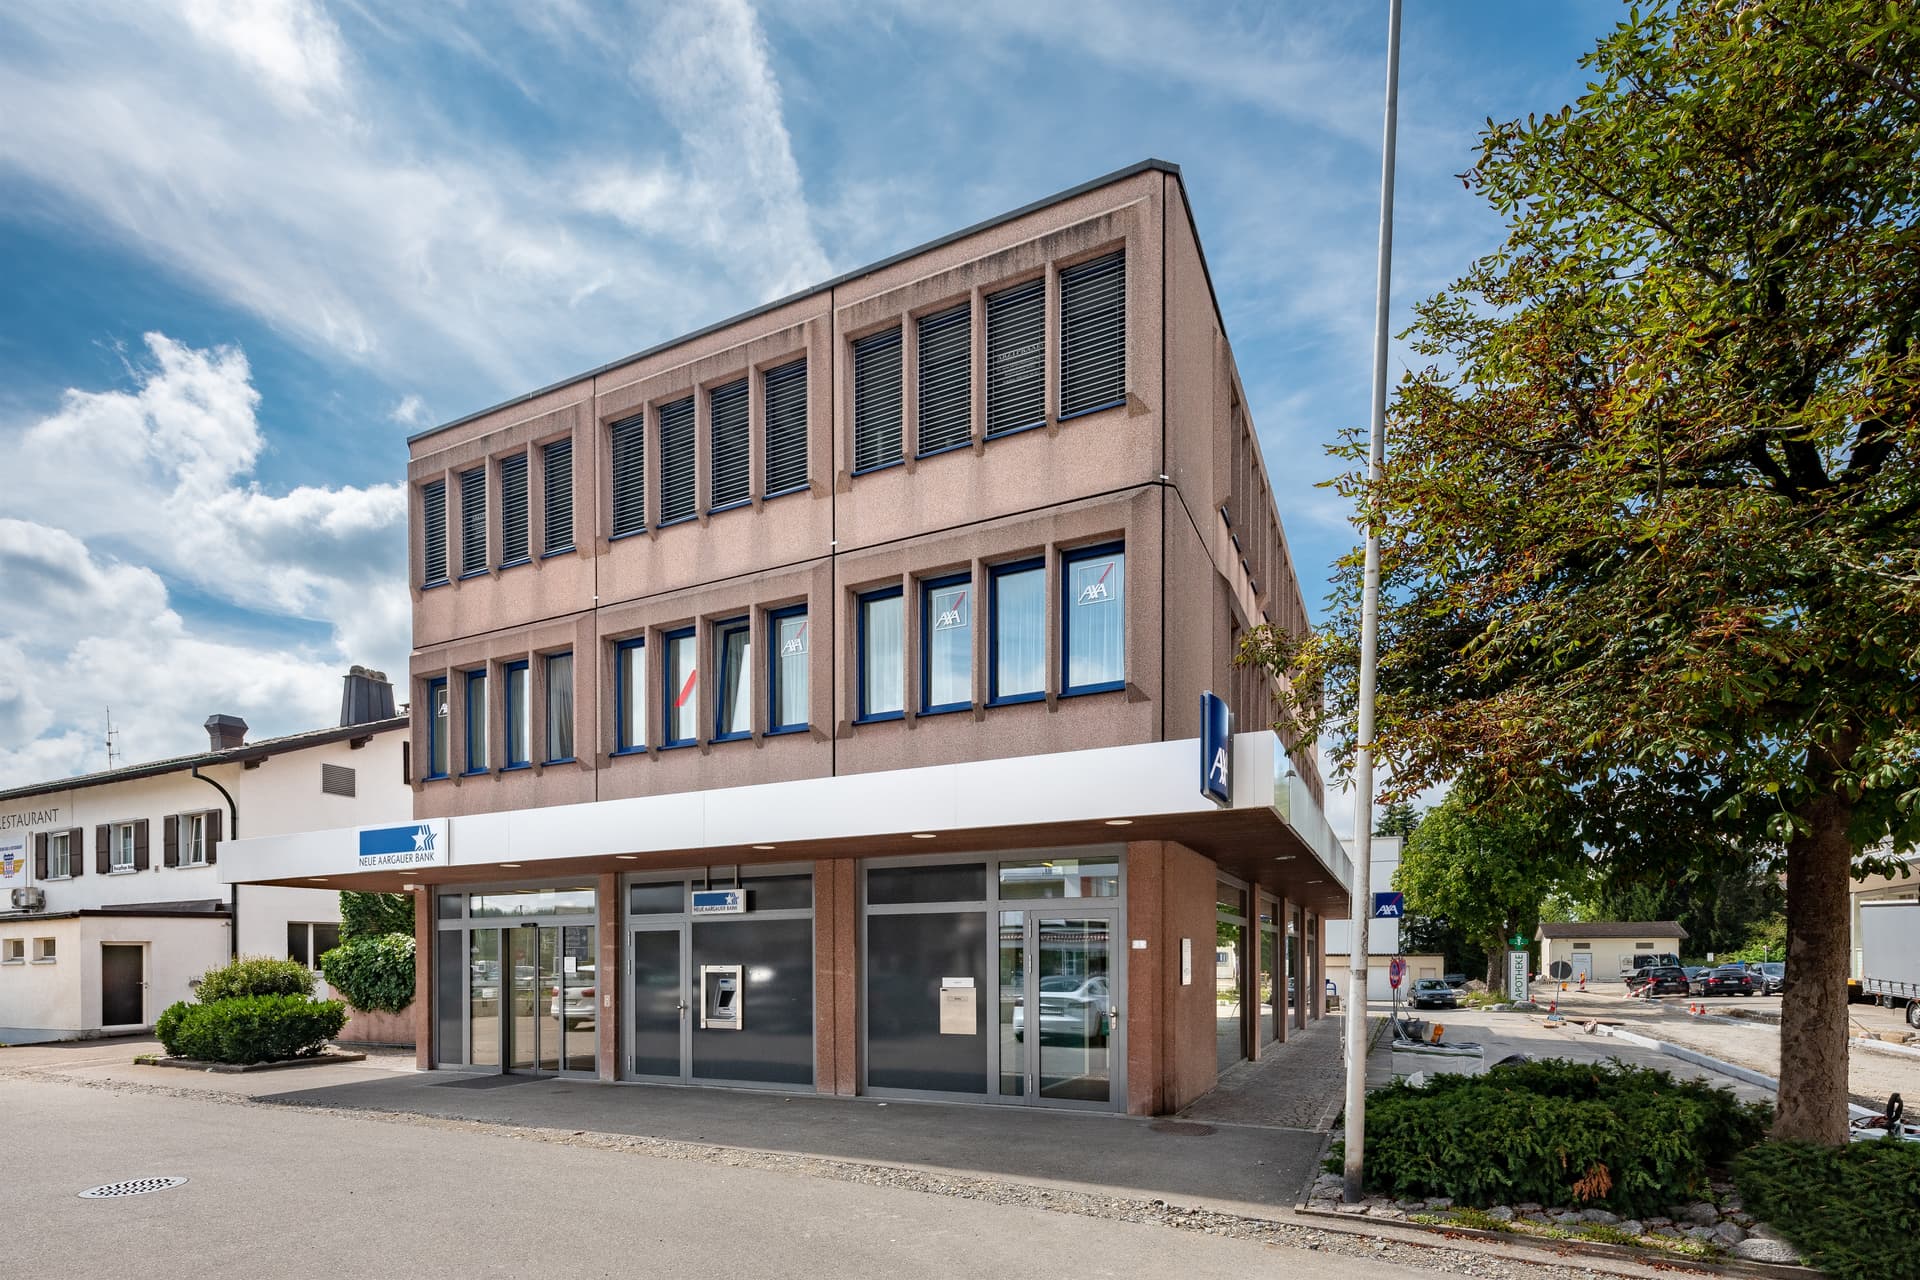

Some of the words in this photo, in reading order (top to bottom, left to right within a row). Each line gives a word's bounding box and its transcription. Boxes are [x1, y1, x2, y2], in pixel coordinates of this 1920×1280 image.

[1079, 583, 1107, 603] AXA
[935, 609, 961, 628] AXA
[782, 638, 803, 653] AXA
[0, 808, 59, 830] ESTAURANT
[359, 855, 377, 867] NEUE
[377, 853, 414, 865] AARGAUER
[415, 852, 435, 863] BANK
[1376, 904, 1399, 916] AXA
[1514, 954, 1524, 998] APOTHEKE
